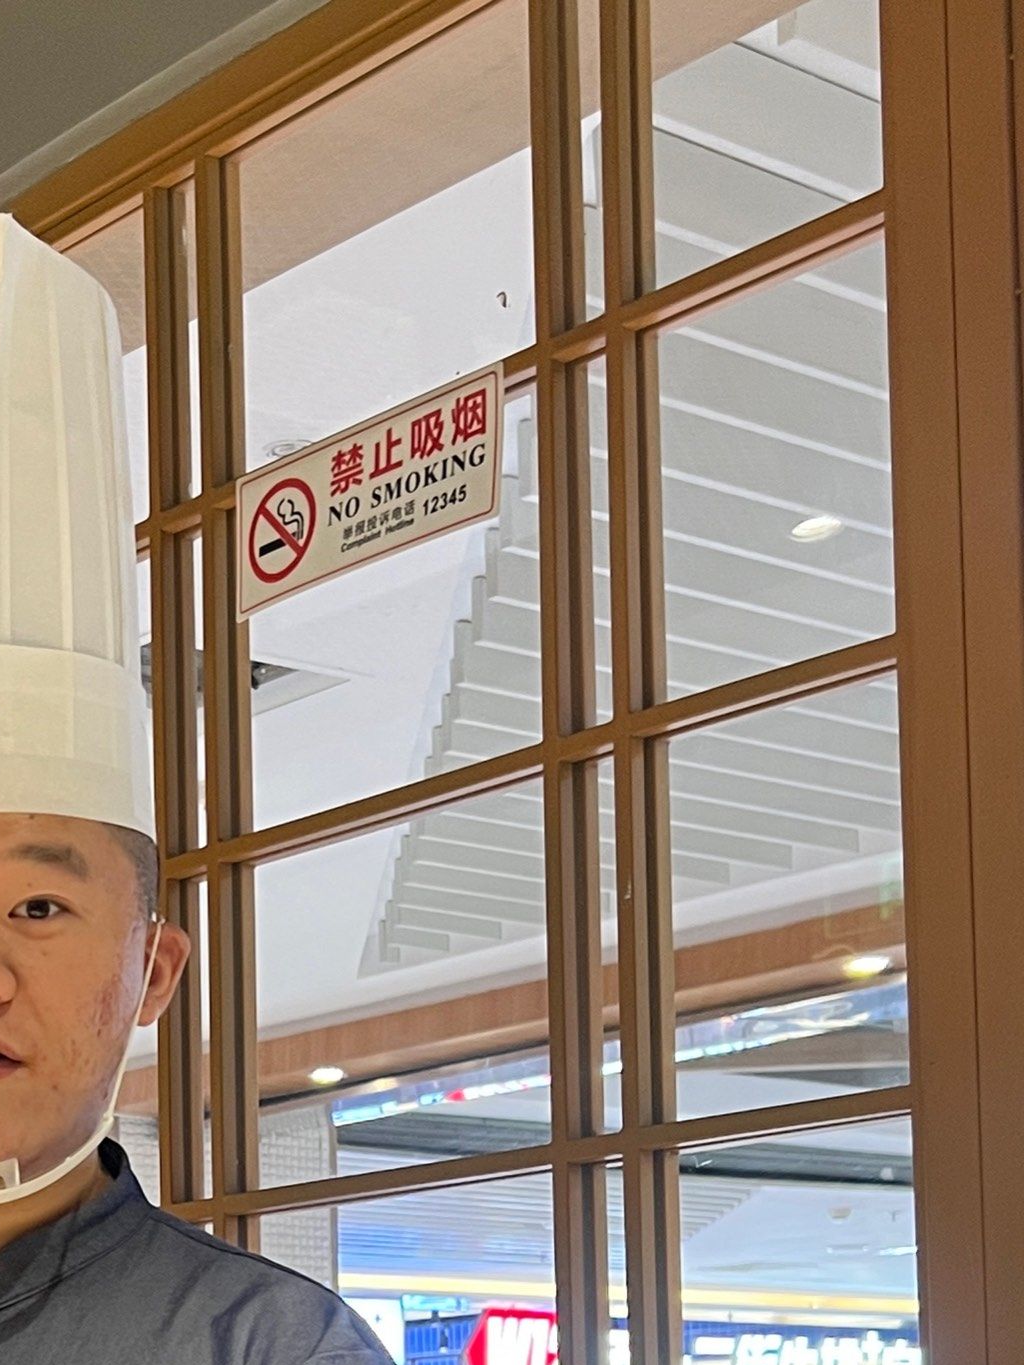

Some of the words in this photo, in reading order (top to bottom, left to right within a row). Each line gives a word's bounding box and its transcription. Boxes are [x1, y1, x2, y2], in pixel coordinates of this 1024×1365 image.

[330, 388, 487, 497] 禁止吸烟
[327, 496, 361, 526] NO
[370, 443, 486, 510] SMOKING
[343, 499, 416, 540] 举报投诉电话
[423, 484, 467, 515] 12345
[384, 518, 415, 536] Hotline
